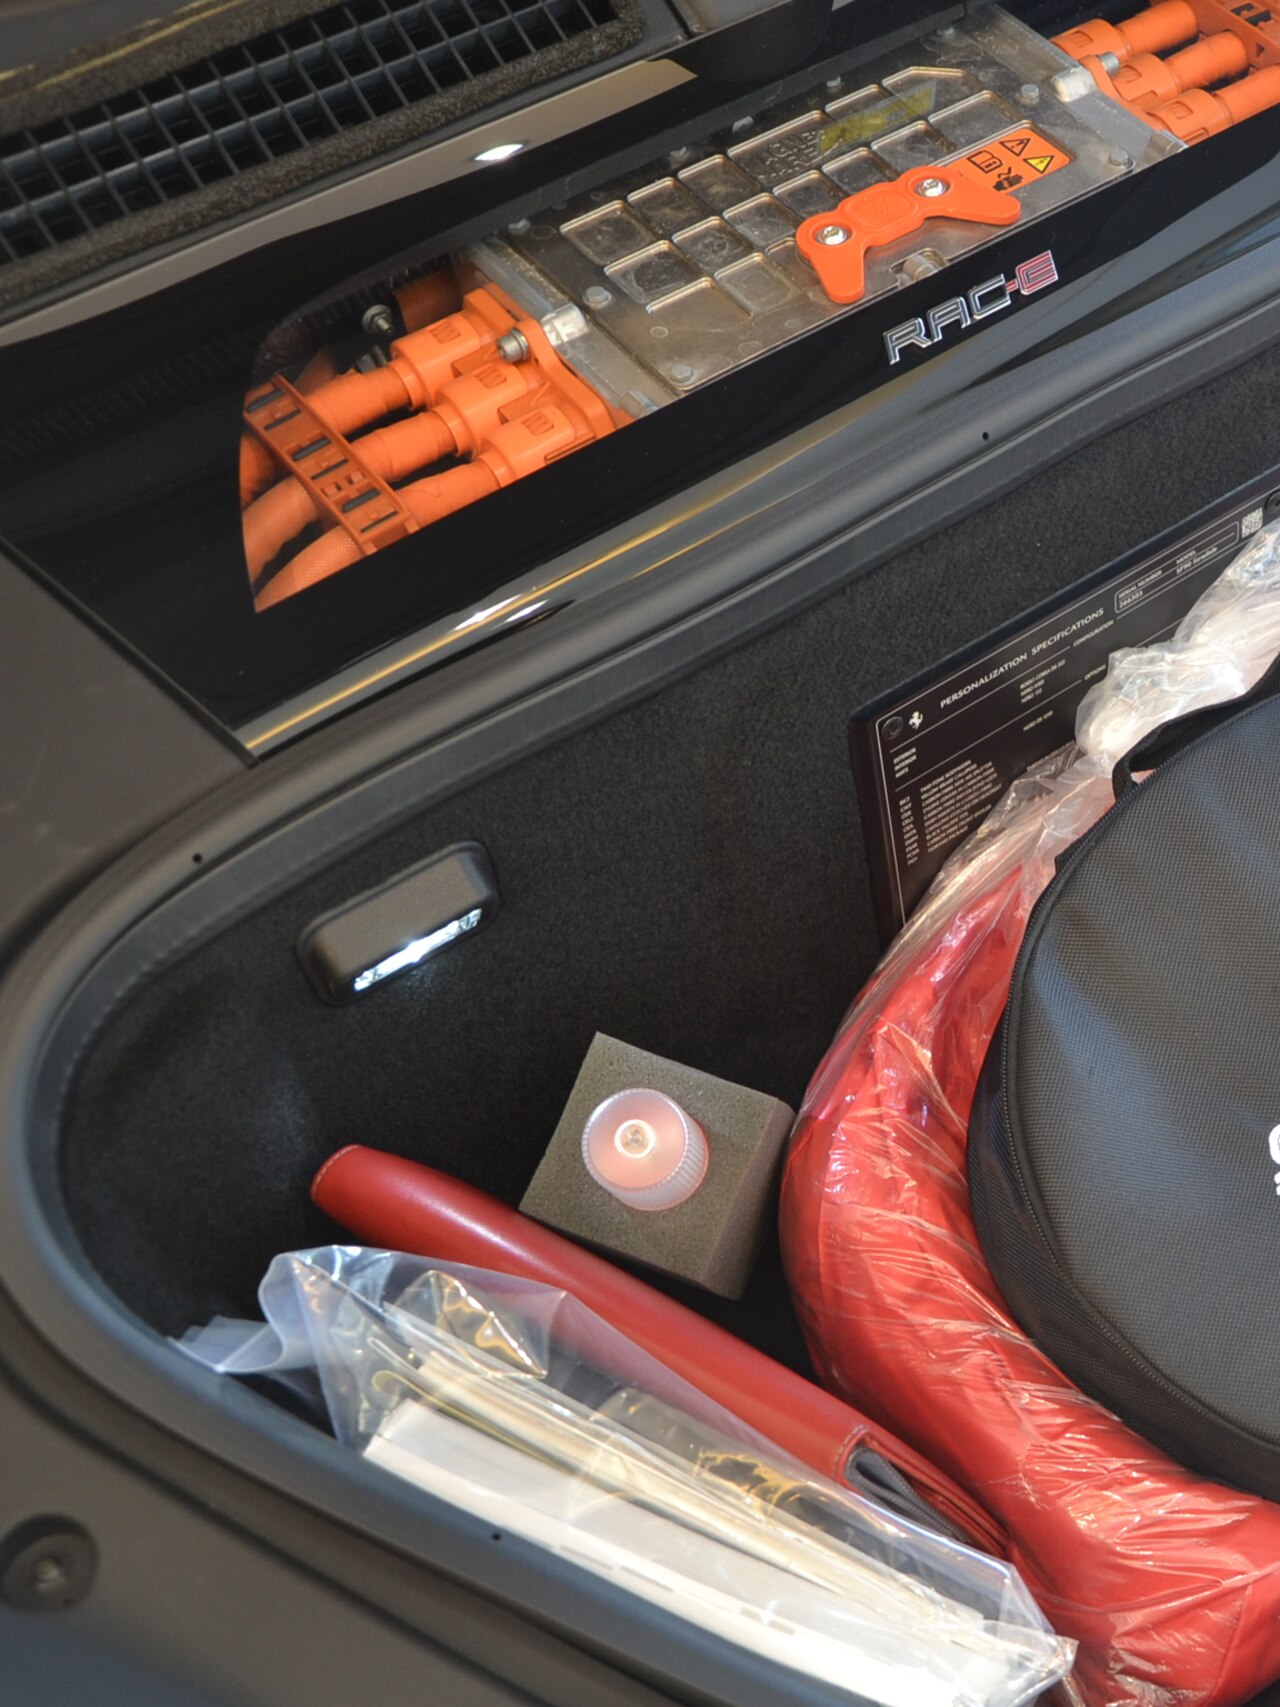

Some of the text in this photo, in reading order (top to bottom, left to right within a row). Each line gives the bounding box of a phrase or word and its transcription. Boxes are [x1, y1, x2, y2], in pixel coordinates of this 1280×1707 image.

[883, 250, 1059, 365] RAC-E
[940, 607, 1104, 708] PERSONALIZATION SPECIFICATIONS
[1073, 618, 1113, 647] CONFIGURATION
